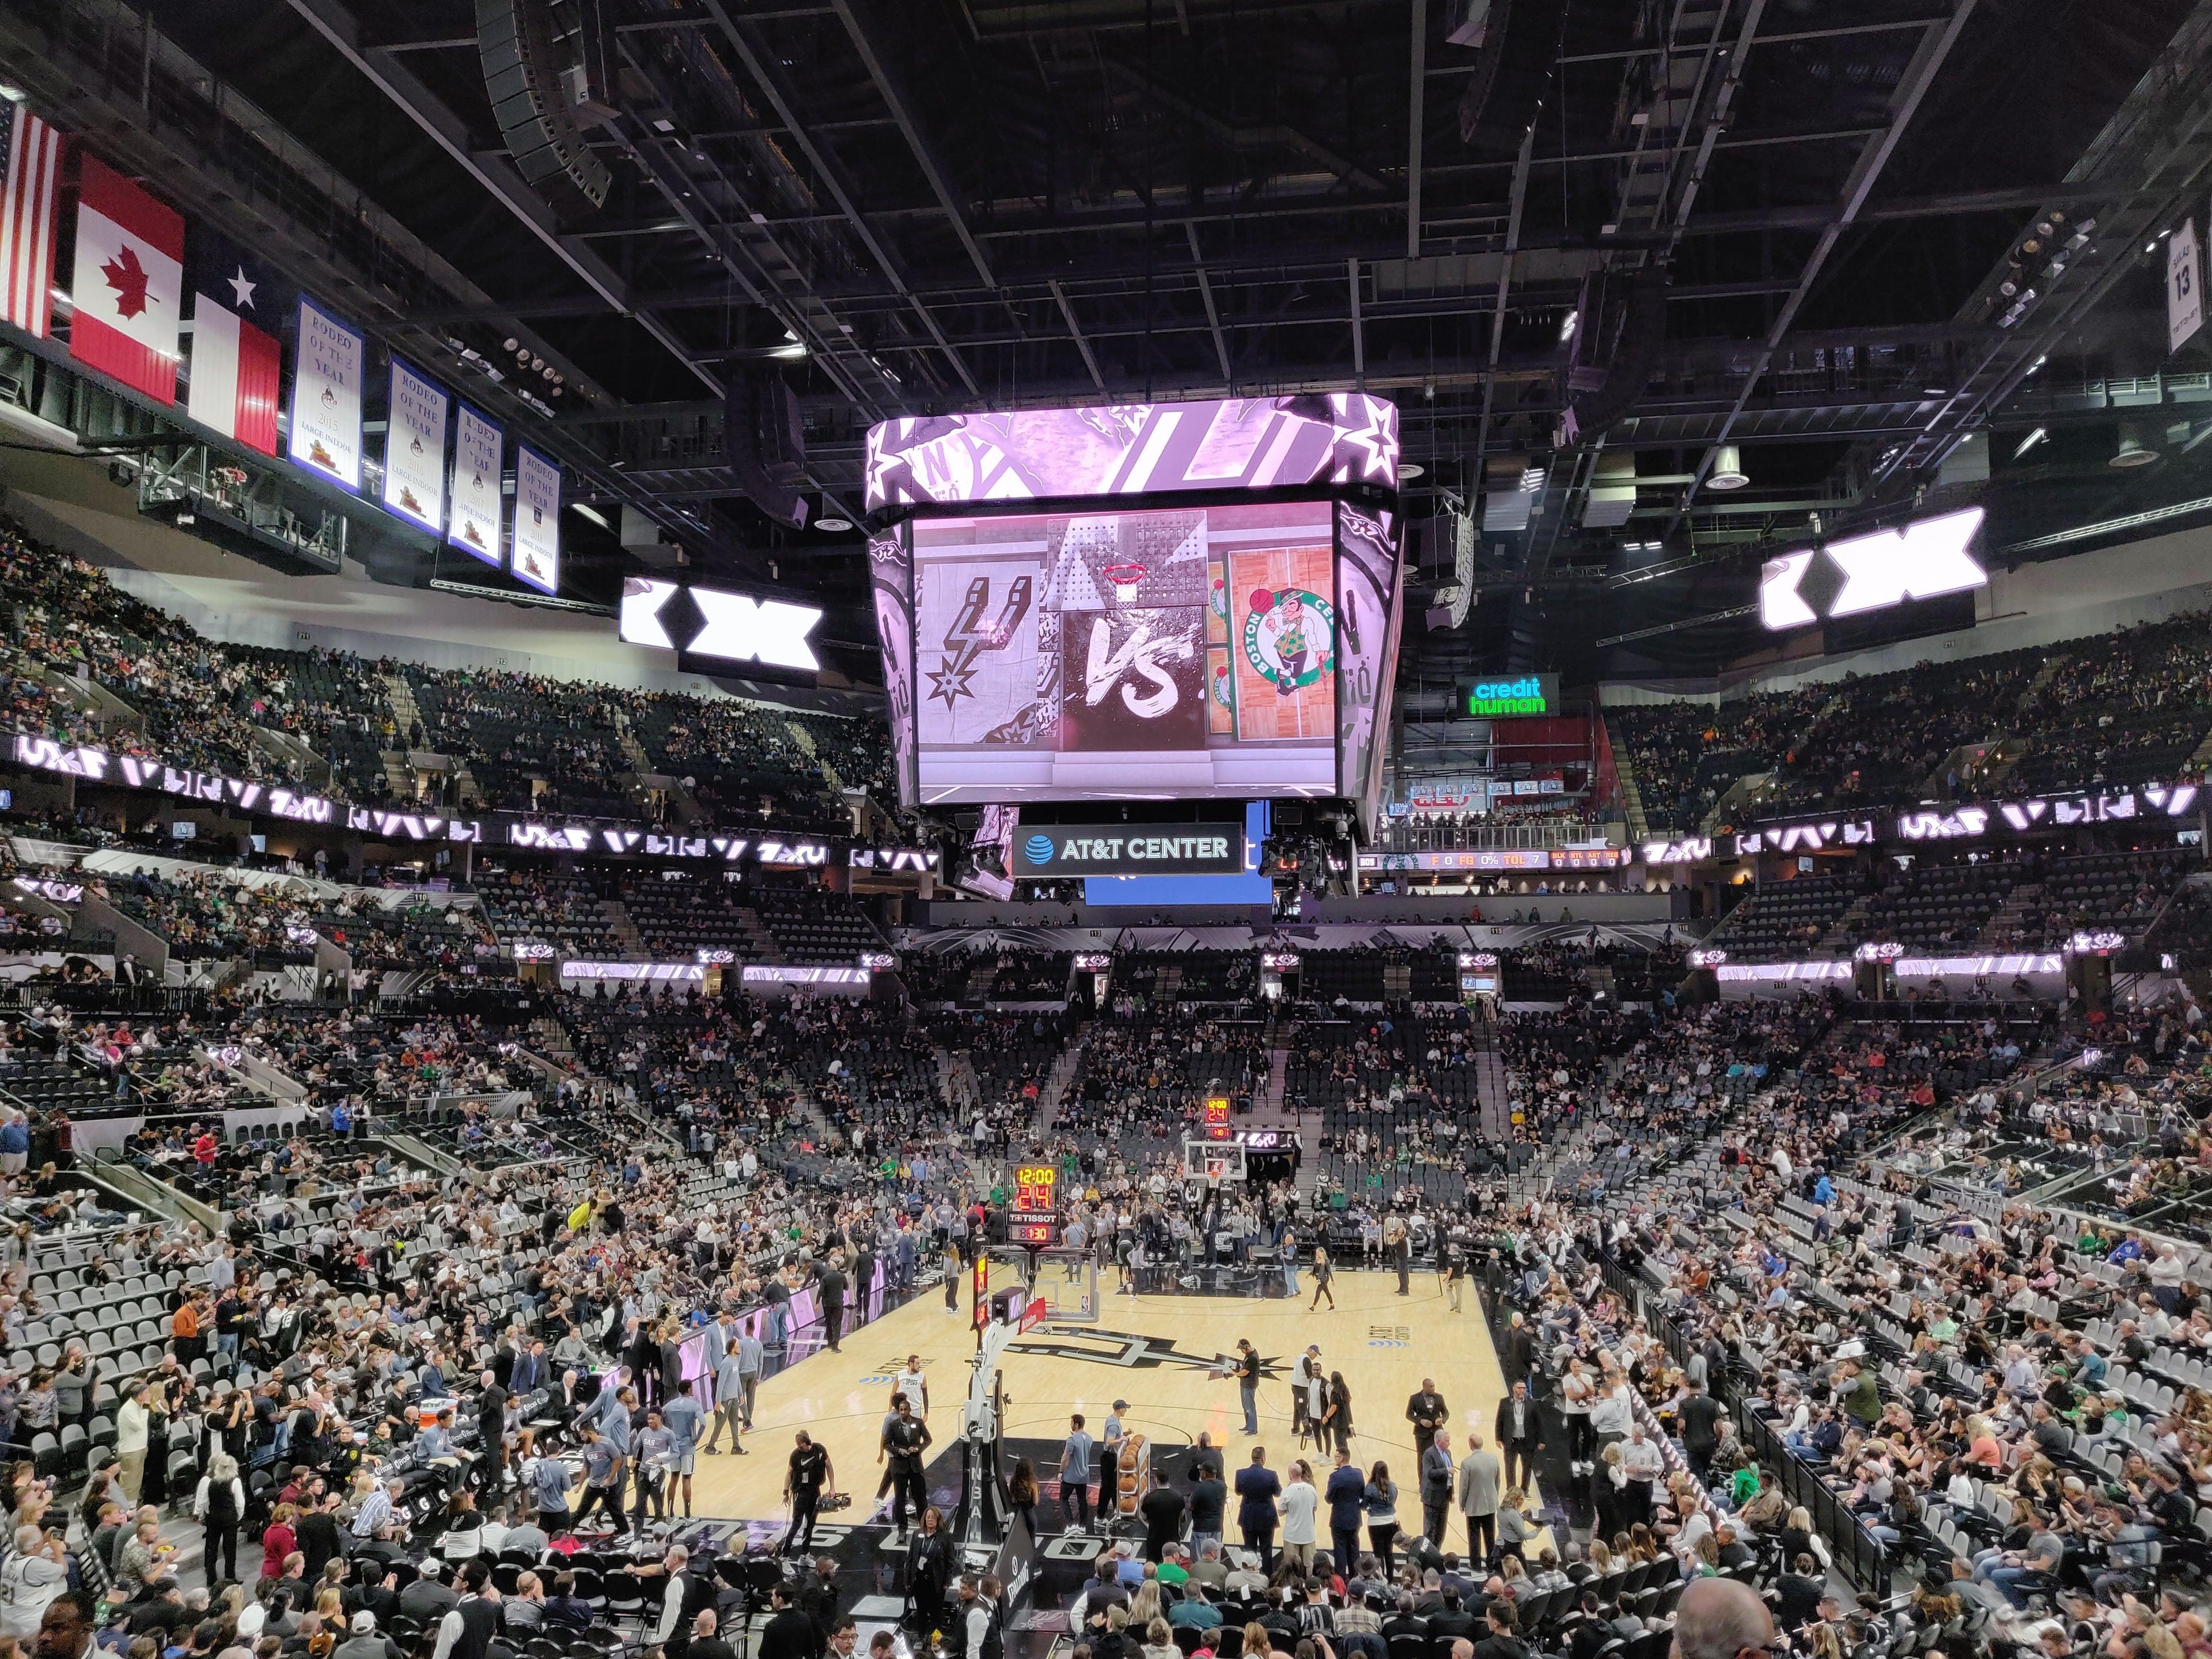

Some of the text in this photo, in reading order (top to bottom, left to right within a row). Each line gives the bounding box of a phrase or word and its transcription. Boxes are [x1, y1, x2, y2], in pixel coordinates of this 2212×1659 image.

[2175, 264, 2190, 301] 13
[313, 316, 351, 349] RODEO
[310, 335, 352, 370] OF THE
[315, 358, 344, 385] YEAR
[403, 374, 437, 405] RODEO
[400, 392, 438, 423] OF THE
[318, 412, 338, 431] 2015
[406, 412, 431, 437] YEAR
[301, 421, 351, 454] LARGE INDOOR
[478, 442, 494, 459] THE
[408, 458, 425, 476] 2016
[527, 456, 553, 480] RODEO
[392, 464, 438, 496] LARGE INDOOR
[525, 472, 553, 497] OF THE
[469, 493, 484, 510] 2017
[528, 490, 548, 509] YEAR
[518, 535, 553, 560] LARGE INDOOR
[1245, 613, 1270, 673] BOSTON
[1086, 618, 1197, 718] VS
[1475, 677, 1540, 698] credit
[1471, 696, 1546, 714] human
[1060, 837, 1228, 859] AT&T CENTER
[1431, 857, 1438, 866] F
[1445, 855, 1452, 865] 0
[1459, 856, 1475, 865] FG
[1480, 855, 1498, 865] 0%
[1503, 855, 1525, 865] TOL
[1532, 855, 1539, 865] 7
[803, 983, 815, 991] 112
[1209, 1100, 1226, 1109] 12:00
[1207, 1108, 1225, 1122] 24
[1019, 1168, 1054, 1184] 12:00
[1017, 1184, 1049, 1209] 24
[1022, 1214, 1056, 1222] TISSOT
[1028, 1228, 1047, 1240] 1:30
[465, 1429, 479, 1437] Frost
[560, 1430, 568, 1442] G
[643, 1438, 655, 1446] SAS
[532, 1444, 541, 1456] G
[586, 1453, 598, 1461] SAS
[381, 1463, 393, 1473] Frost
[399, 1454, 411, 1466] Frost
[471, 1472, 480, 1486] G
[419, 1497, 431, 1511] G
[439, 1488, 449, 1502] G
[402, 1506, 412, 1520] G
[1008, 1559, 1029, 1608] SPALDING
